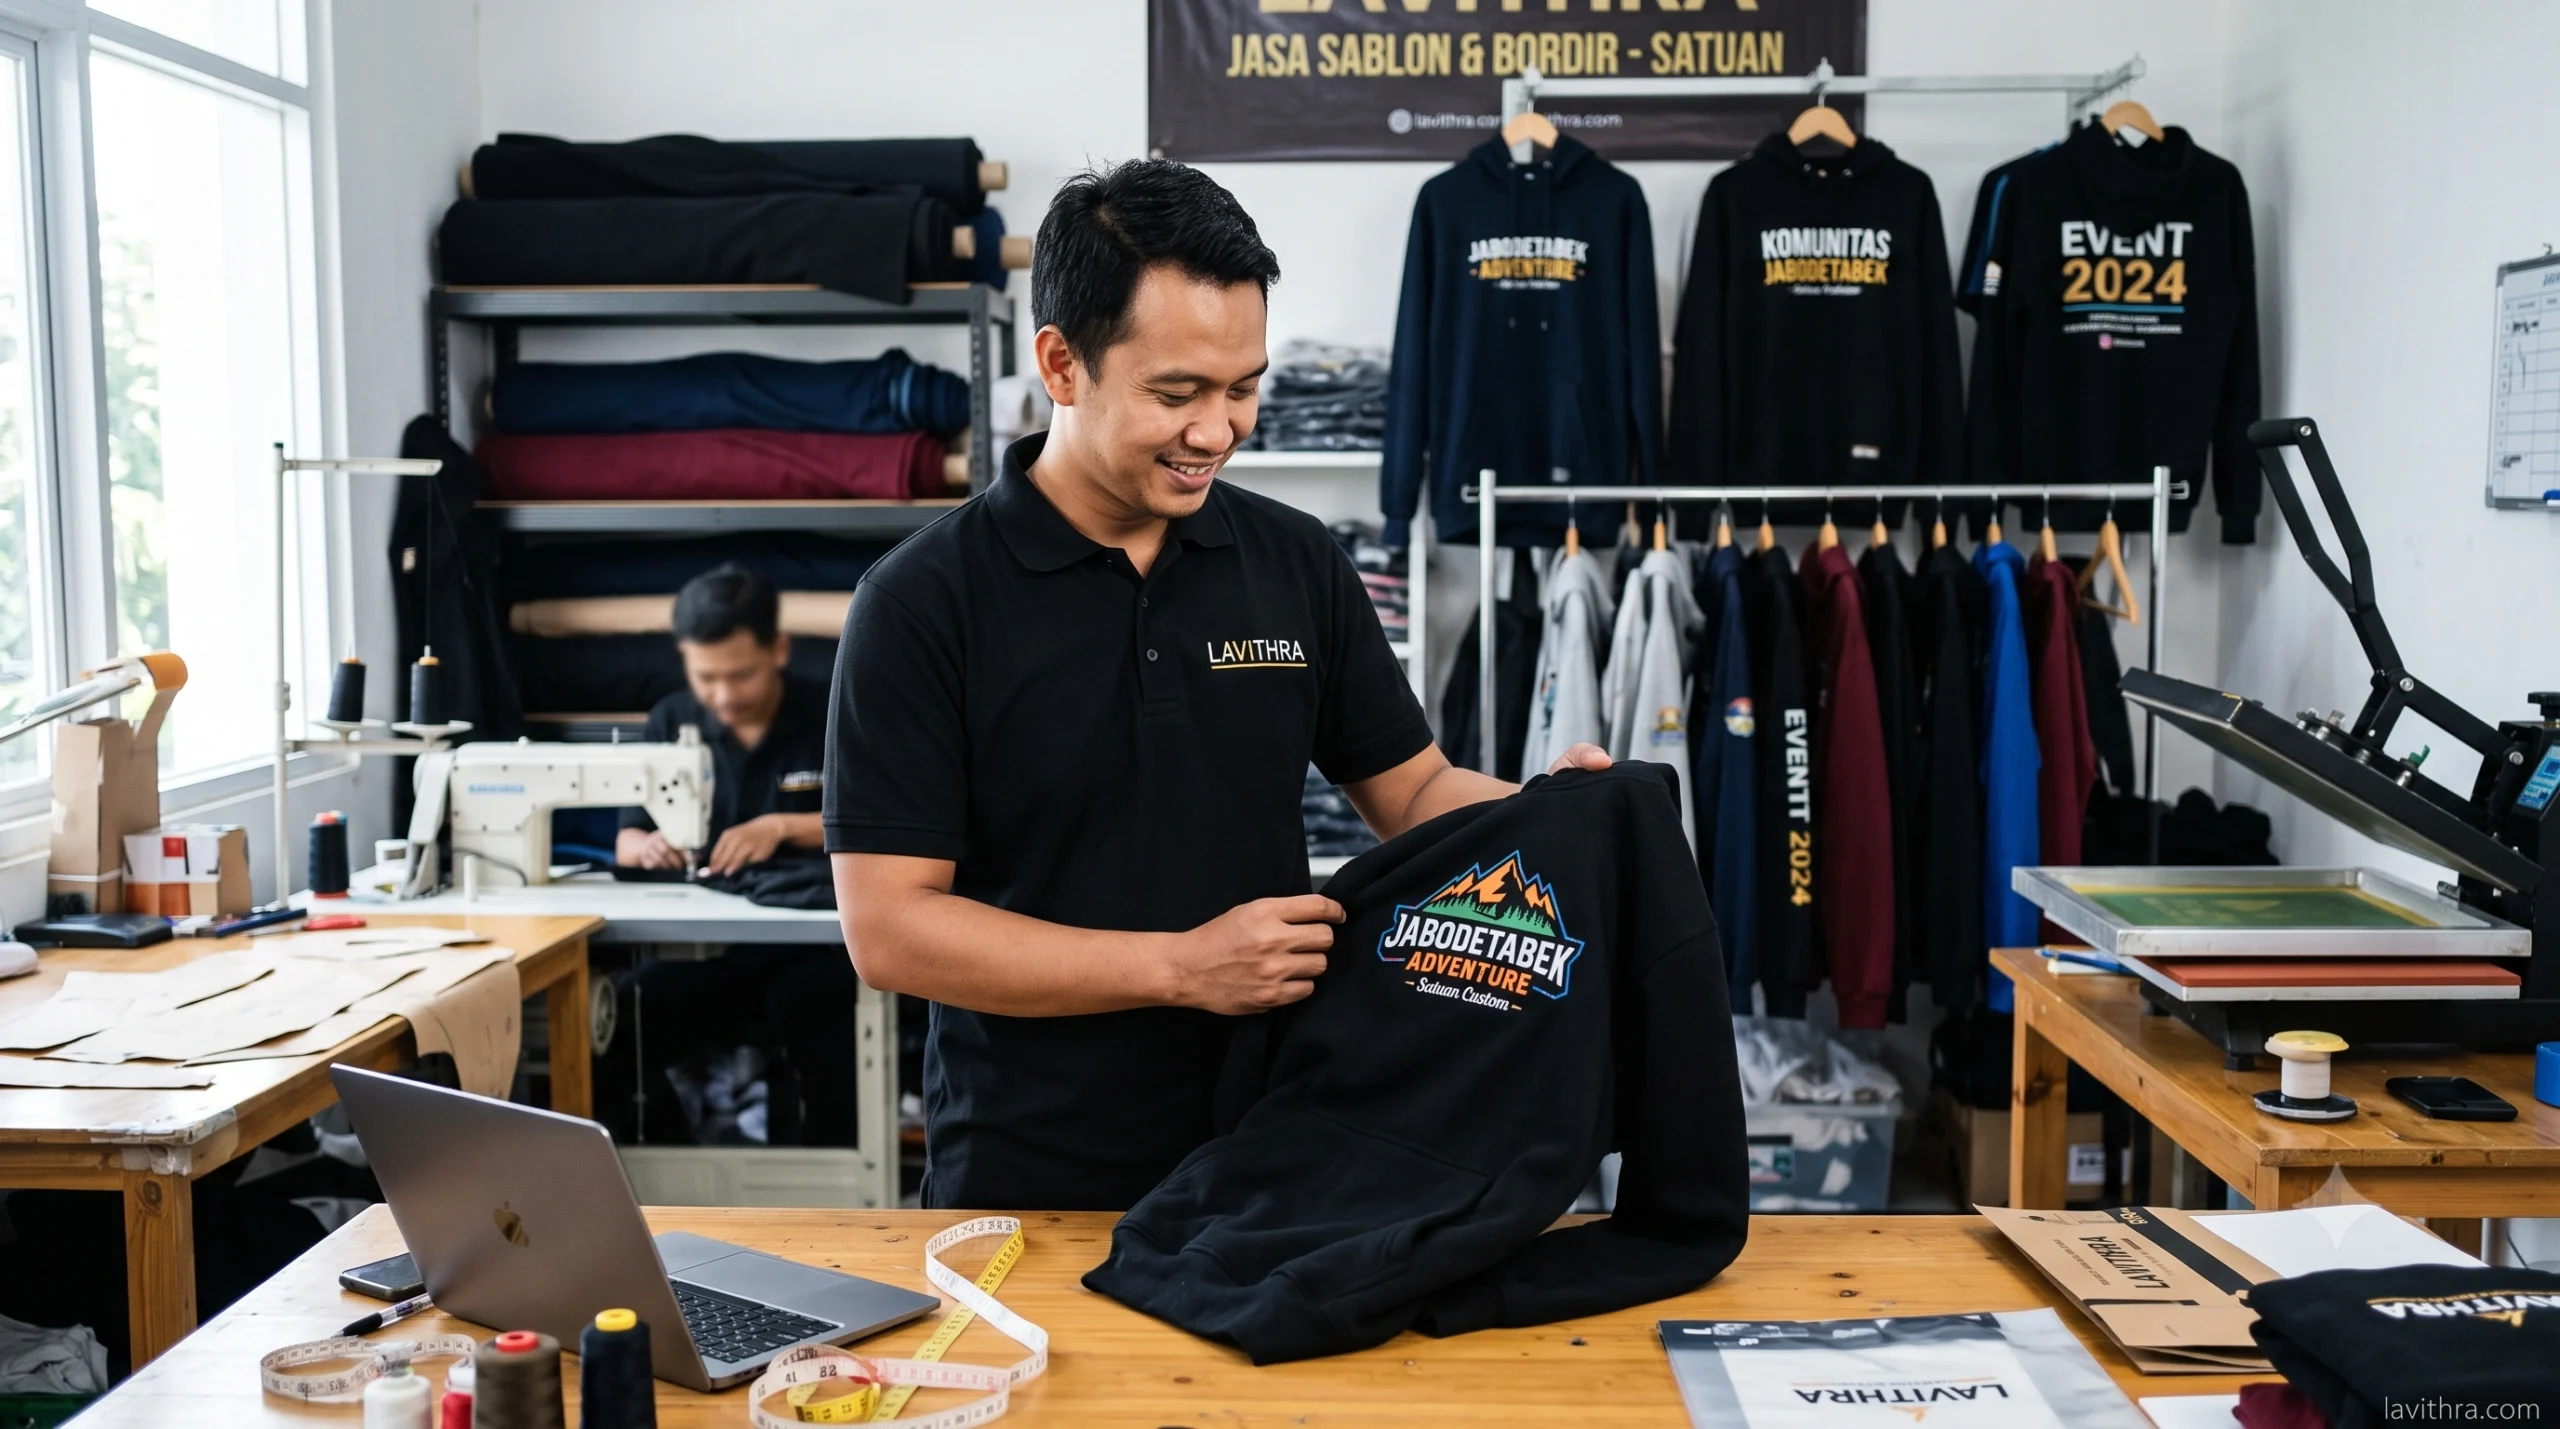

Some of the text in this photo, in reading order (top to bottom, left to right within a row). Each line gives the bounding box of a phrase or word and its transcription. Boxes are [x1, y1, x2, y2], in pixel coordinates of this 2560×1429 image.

[1227, 33, 1311, 77] JASA
[1317, 33, 1451, 77] SABLON
[1459, 32, 1485, 76] &
[1493, 32, 1619, 75] BORDIR
[1650, 31, 1785, 75] SATUAN
[1468, 236, 1590, 263] JABODETABEK
[1760, 227, 1892, 260] KOMUNITAS
[2061, 220, 2193, 257] EVENT
[1763, 258, 1890, 286] JABODETABEK
[2062, 257, 2188, 304] 2024
[1207, 639, 1306, 664] LAVITHRA
[1784, 708, 1813, 906] EVENTT 2024
[1384, 913, 1575, 987] JABODETABEK
[1405, 951, 1533, 996] ADVENTURE
[1461, 986, 1510, 1012] Custom
[2371, 1295, 2560, 1319] AVITHRA
[1793, 1384, 2010, 1405] LAVITHRA
